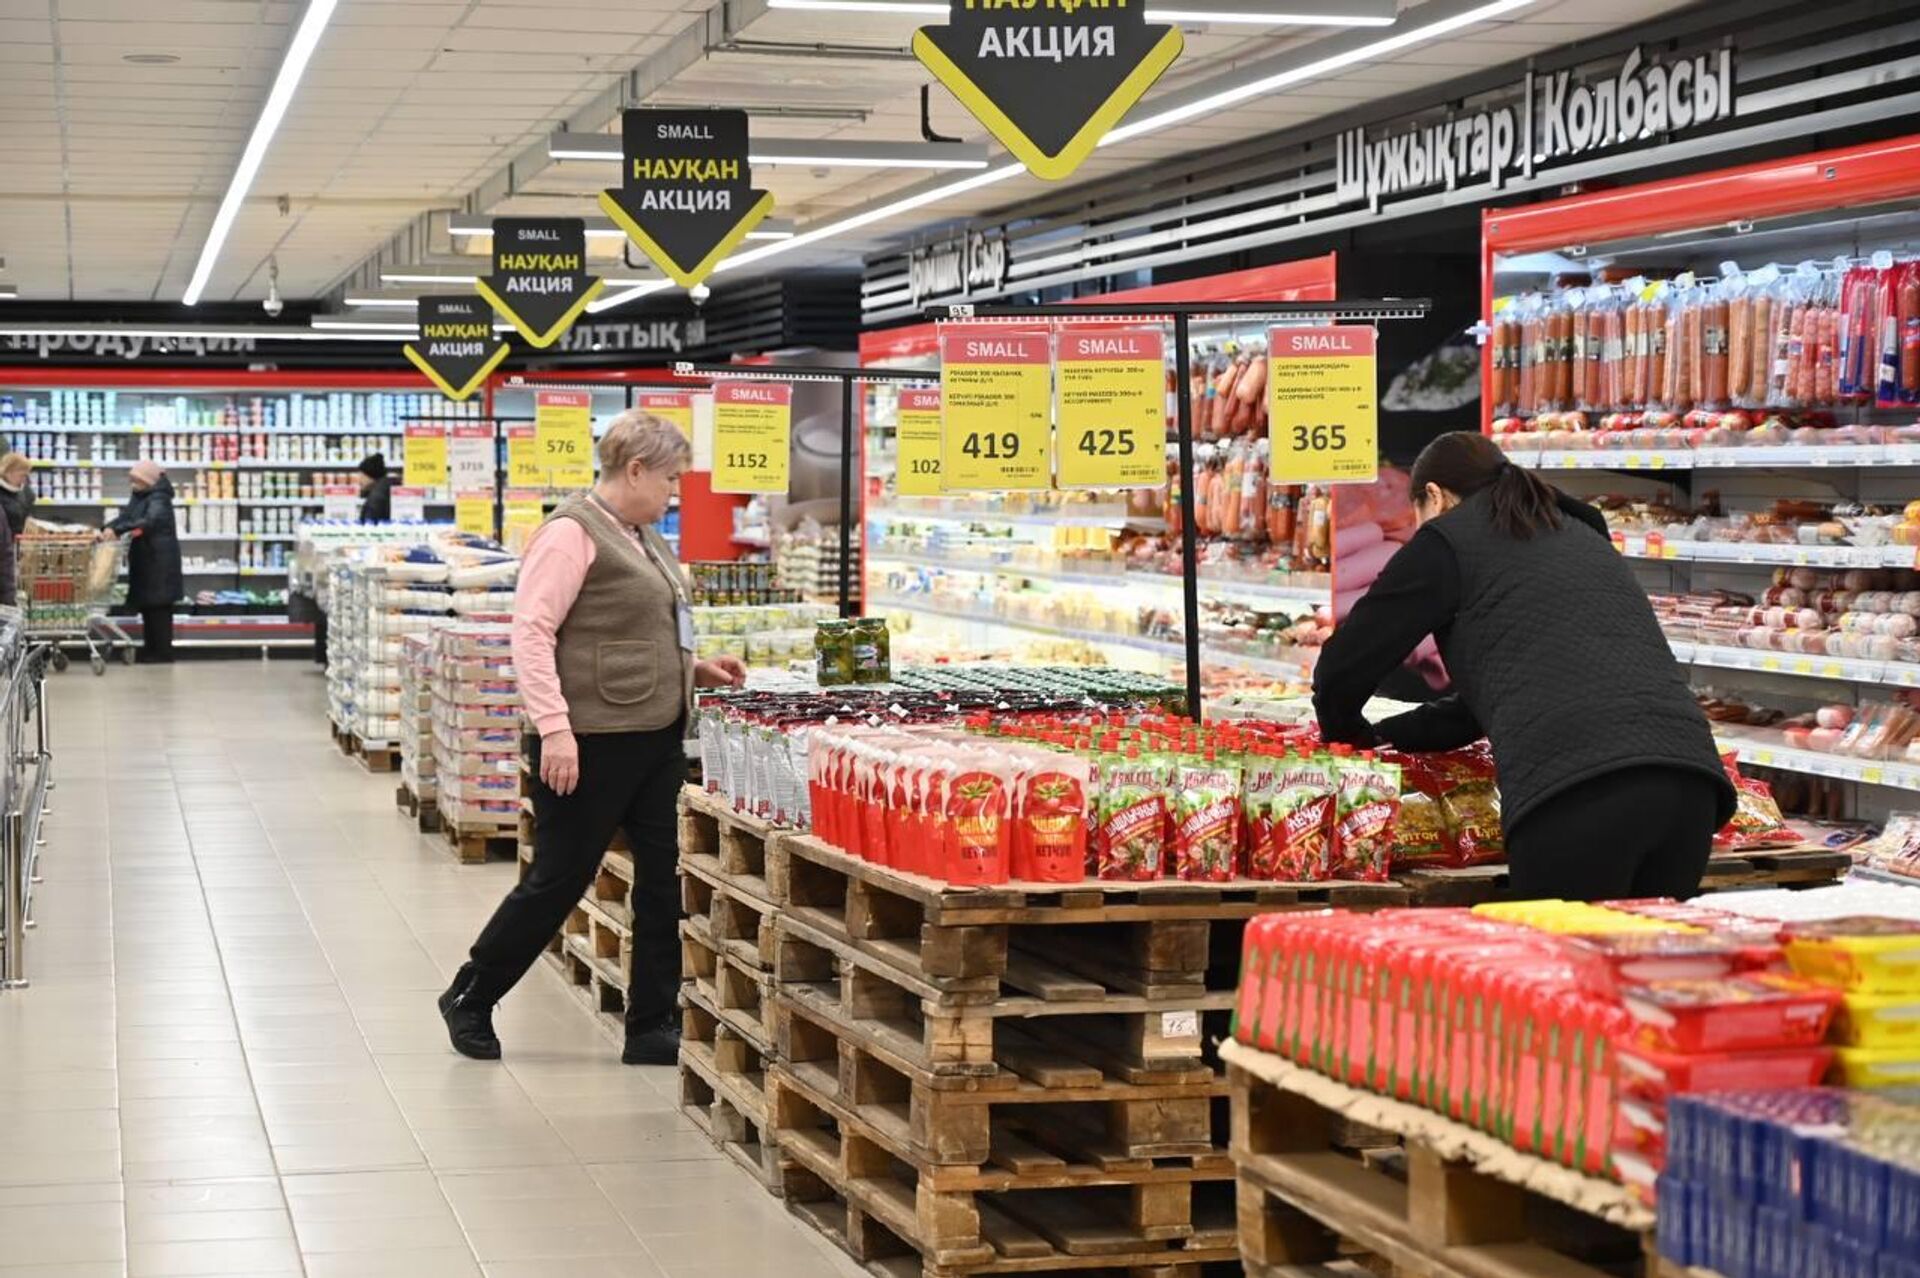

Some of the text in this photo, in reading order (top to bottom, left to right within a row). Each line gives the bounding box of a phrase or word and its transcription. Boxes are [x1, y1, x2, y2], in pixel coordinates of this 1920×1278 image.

[978, 25, 1116, 63] АКЦИЯ
[657, 124, 714, 140] SMALL
[1336, 47, 1732, 215] Шұжықтар Колбасы
[633, 158, 738, 182] НАУҚАН
[641, 190, 731, 213] АКЦИЯ
[518, 229, 561, 241] SMALL
[500, 254, 579, 271] НАУҚАН
[969, 231, 1005, 293] Сыр
[506, 276, 573, 294] АКЦИЯ
[437, 304, 472, 314] SMALL
[424, 324, 488, 339] НАУҚАН
[429, 343, 484, 357] АКЦИЯ
[966, 341, 1029, 357] SMALL
[1078, 339, 1140, 355] SMALL
[1291, 335, 1352, 351] SMALL
[731, 388, 775, 400] SMALL
[913, 395, 940, 407] SMA
[962, 432, 1019, 459] 419
[1079, 429, 1135, 456] 425
[1292, 424, 1347, 451] 365
[546, 440, 575, 454] 576
[727, 453, 768, 468] 1152
[912, 459, 940, 474] 102
